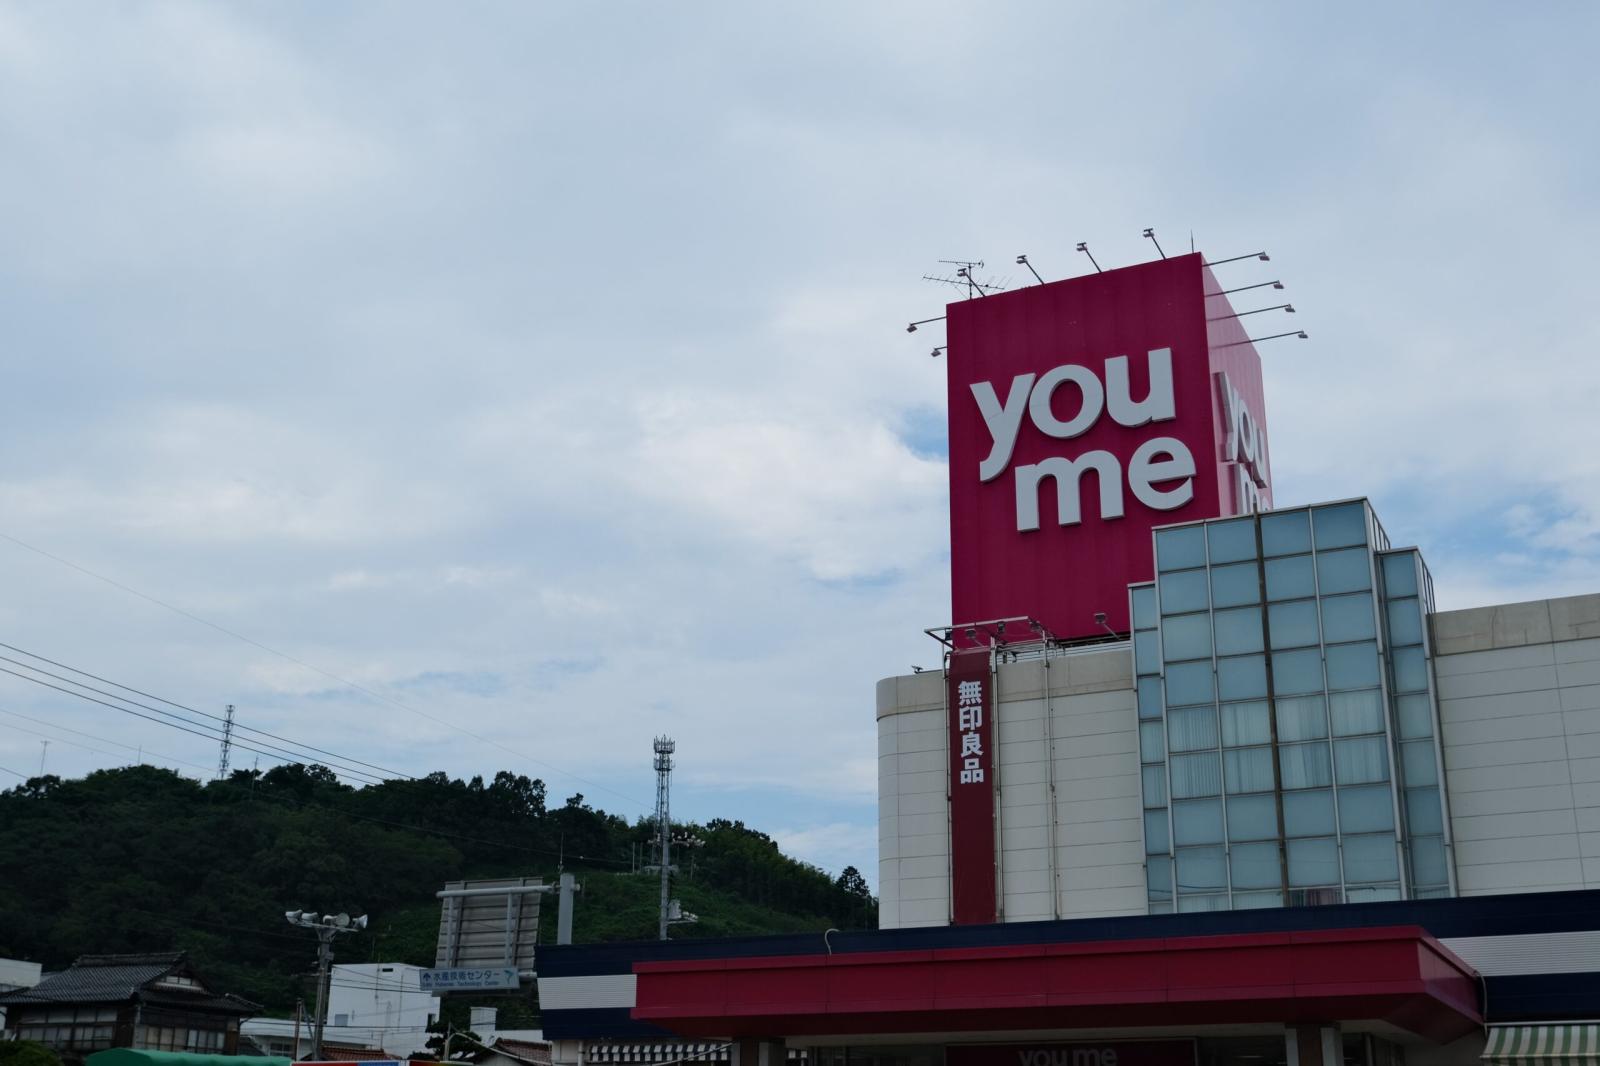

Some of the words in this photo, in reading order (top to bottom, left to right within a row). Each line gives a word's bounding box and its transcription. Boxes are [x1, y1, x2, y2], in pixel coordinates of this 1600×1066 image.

[969, 347, 1176, 482] you
[1213, 372, 1268, 488] you
[1015, 437, 1196, 533] me
[958, 680, 985, 784] 無印良品
[1073, 1048, 1119, 1066] me
